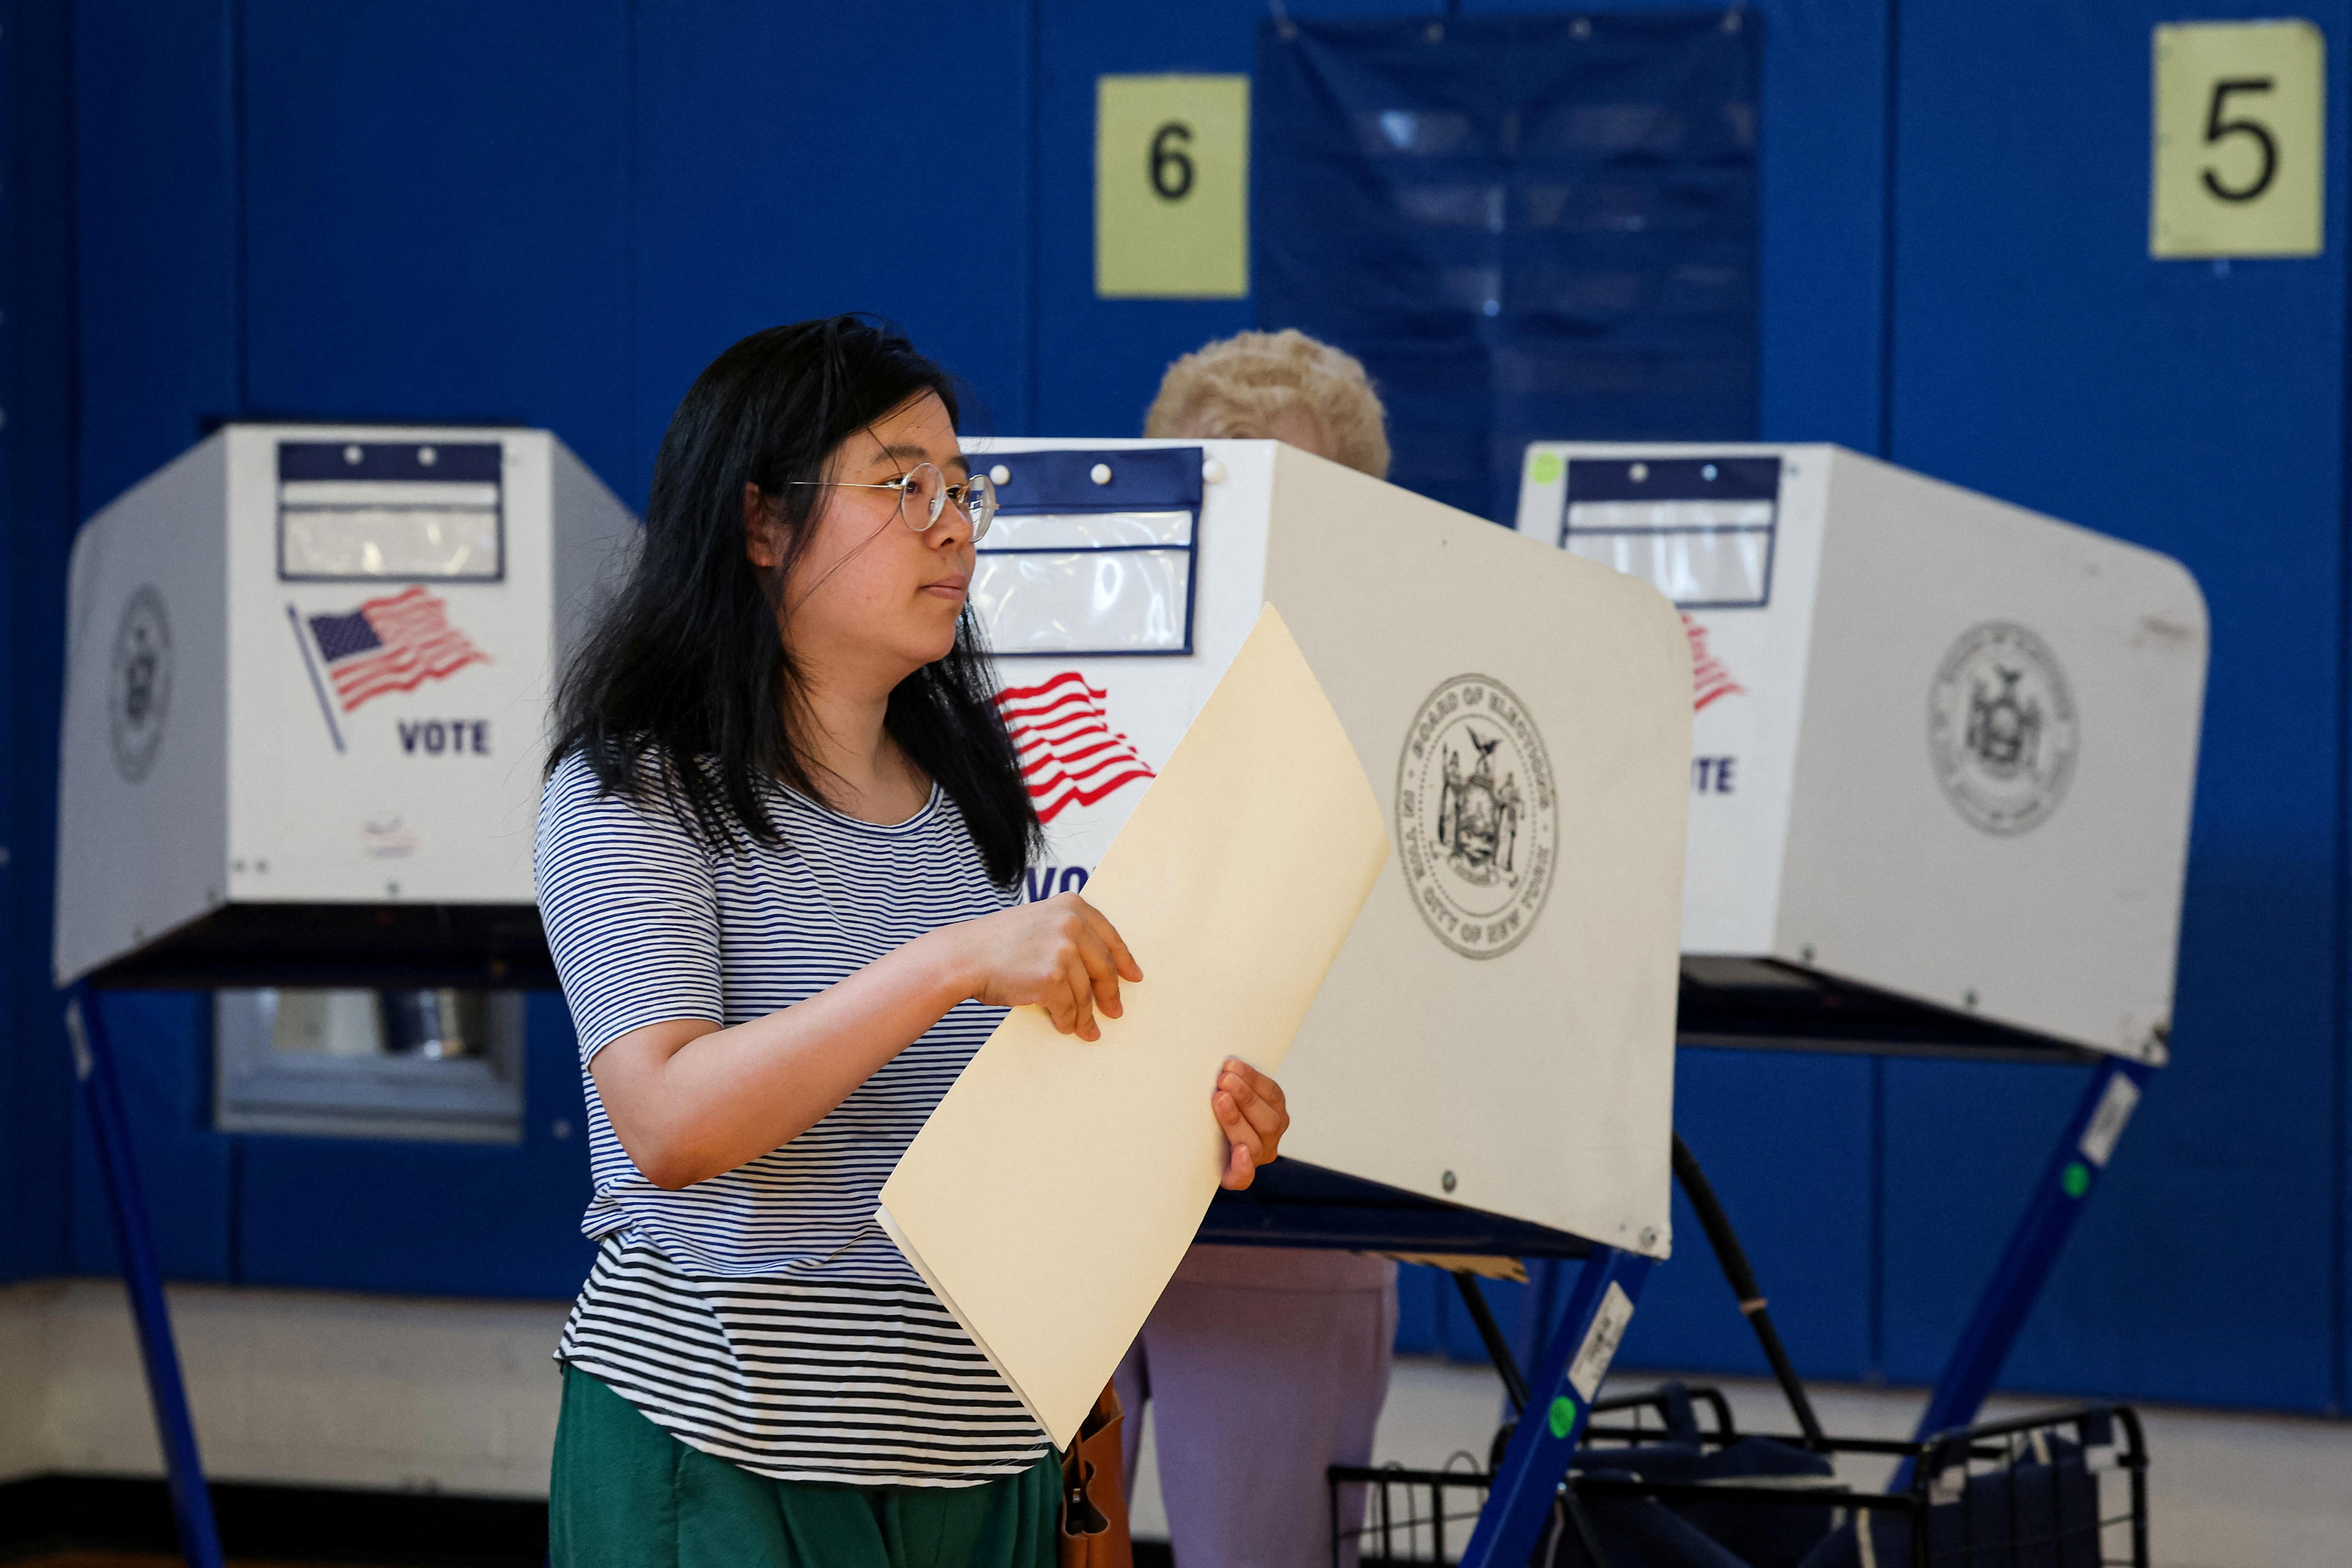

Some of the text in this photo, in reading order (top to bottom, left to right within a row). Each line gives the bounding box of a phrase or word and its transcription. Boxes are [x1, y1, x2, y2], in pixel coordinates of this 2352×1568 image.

[1149, 122, 1196, 202] 6
[2202, 78, 2279, 203] 5
[398, 719, 491, 755] VOTE
[1412, 691, 1458, 759] BOARD
[1463, 685, 1484, 706] OF
[1691, 757, 1736, 795] TE
[1027, 867, 1089, 903] VO
